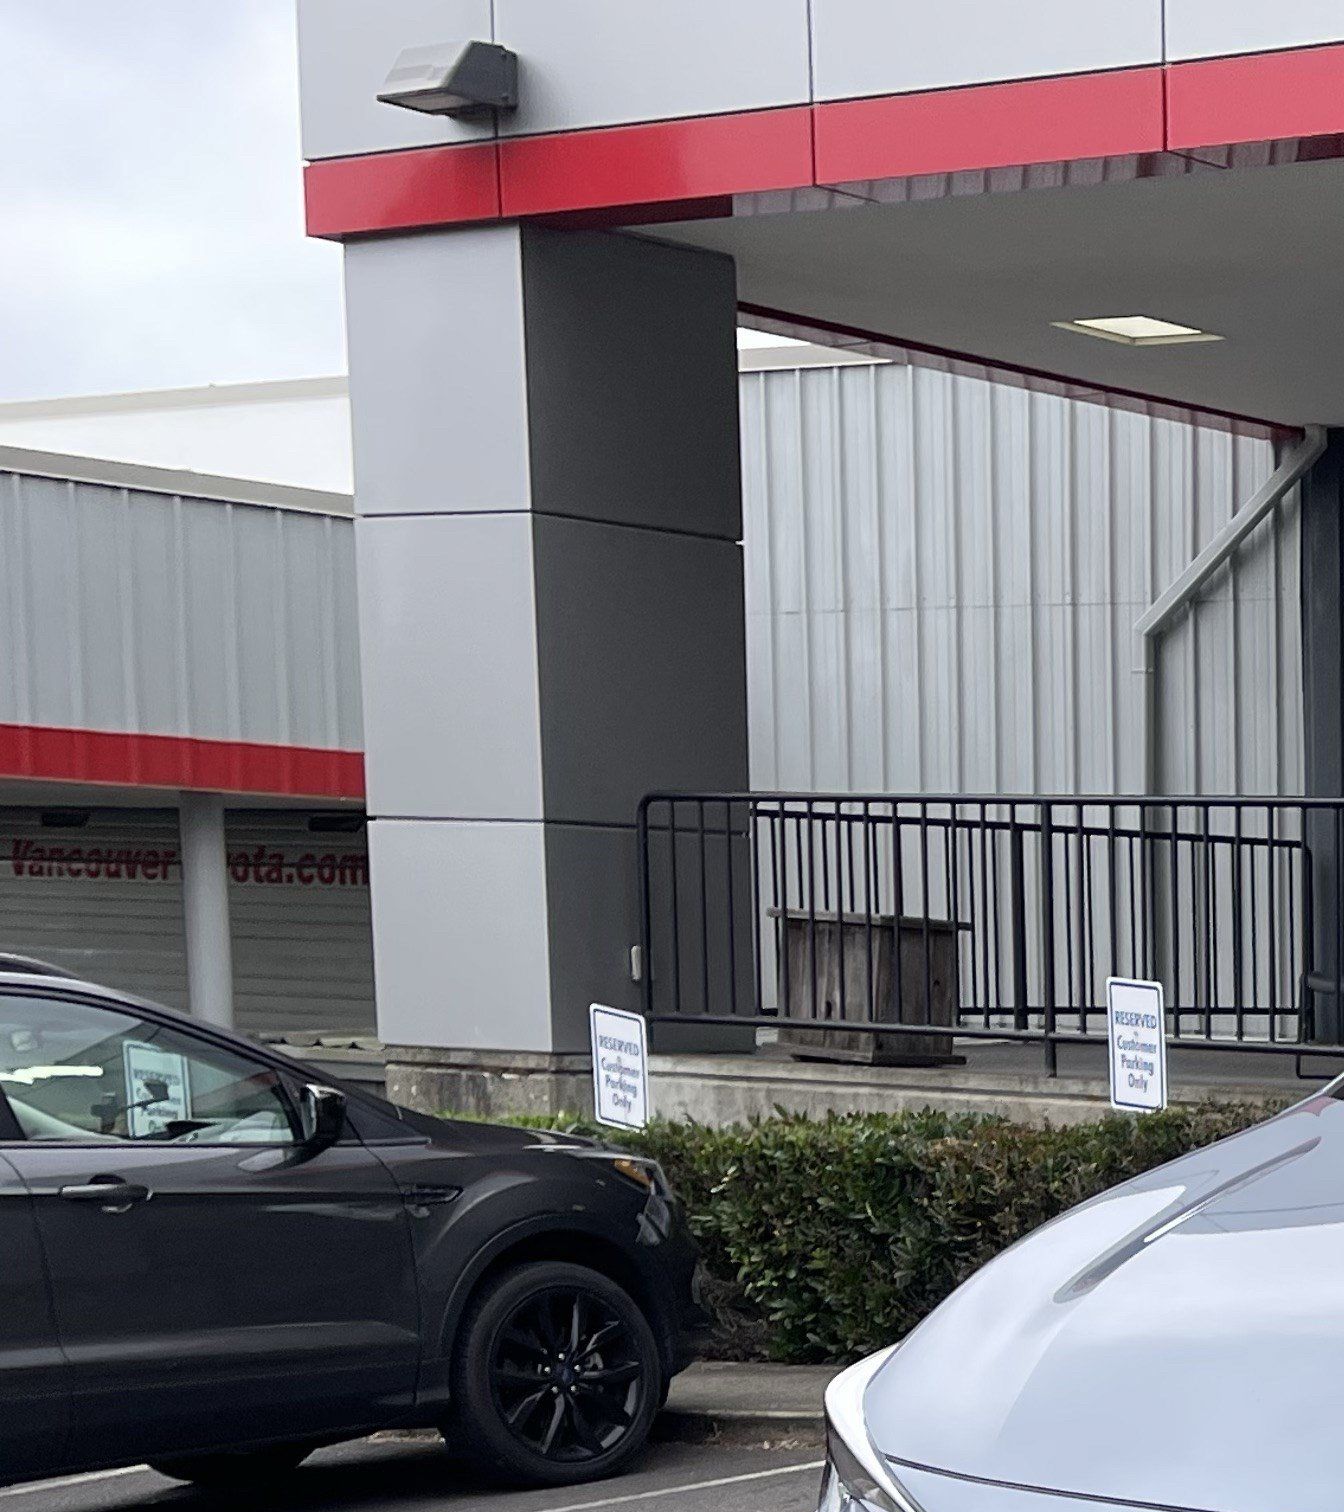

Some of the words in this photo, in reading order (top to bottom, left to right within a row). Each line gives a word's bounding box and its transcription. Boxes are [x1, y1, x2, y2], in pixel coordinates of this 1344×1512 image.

[1114, 1010, 1157, 1029] RESERVED
[598, 1034, 640, 1056] RESERVED
[1117, 1034, 1157, 1054] Customer
[601, 1057, 640, 1079] Customer
[1121, 1053, 1154, 1076] Parking
[605, 1074, 638, 1098] Parking
[1128, 1073, 1149, 1093] Only
[611, 1092, 632, 1114] Only
